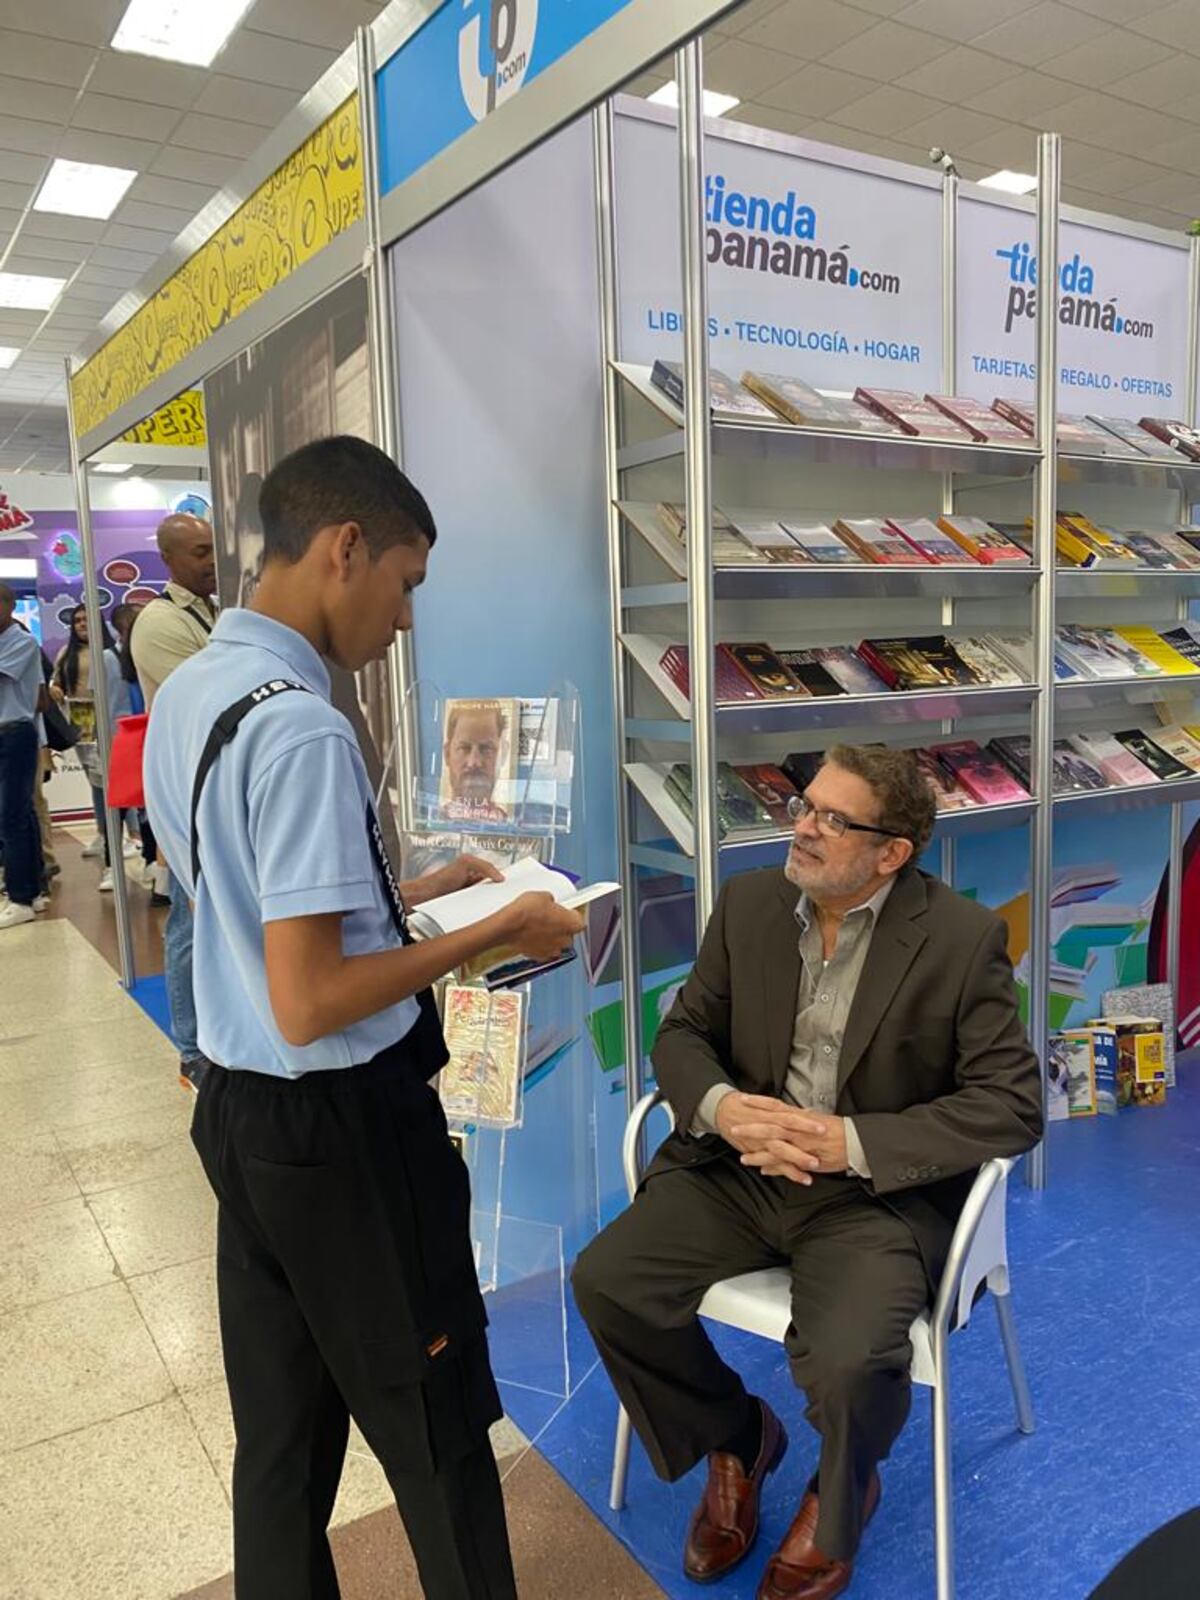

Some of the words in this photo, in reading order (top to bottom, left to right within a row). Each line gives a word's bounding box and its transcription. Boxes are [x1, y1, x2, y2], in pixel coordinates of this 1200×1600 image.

[996, 243, 1094, 295] tieda
[648, 310, 719, 337] LIBS
[735, 321, 850, 355] TECNOLOGÍA
[864, 340, 921, 363] HOGAR
[1004, 286, 1153, 339] paamá.com
[1061, 368, 1111, 390] REGALO
[1121, 377, 1173, 398] OFERTAS
